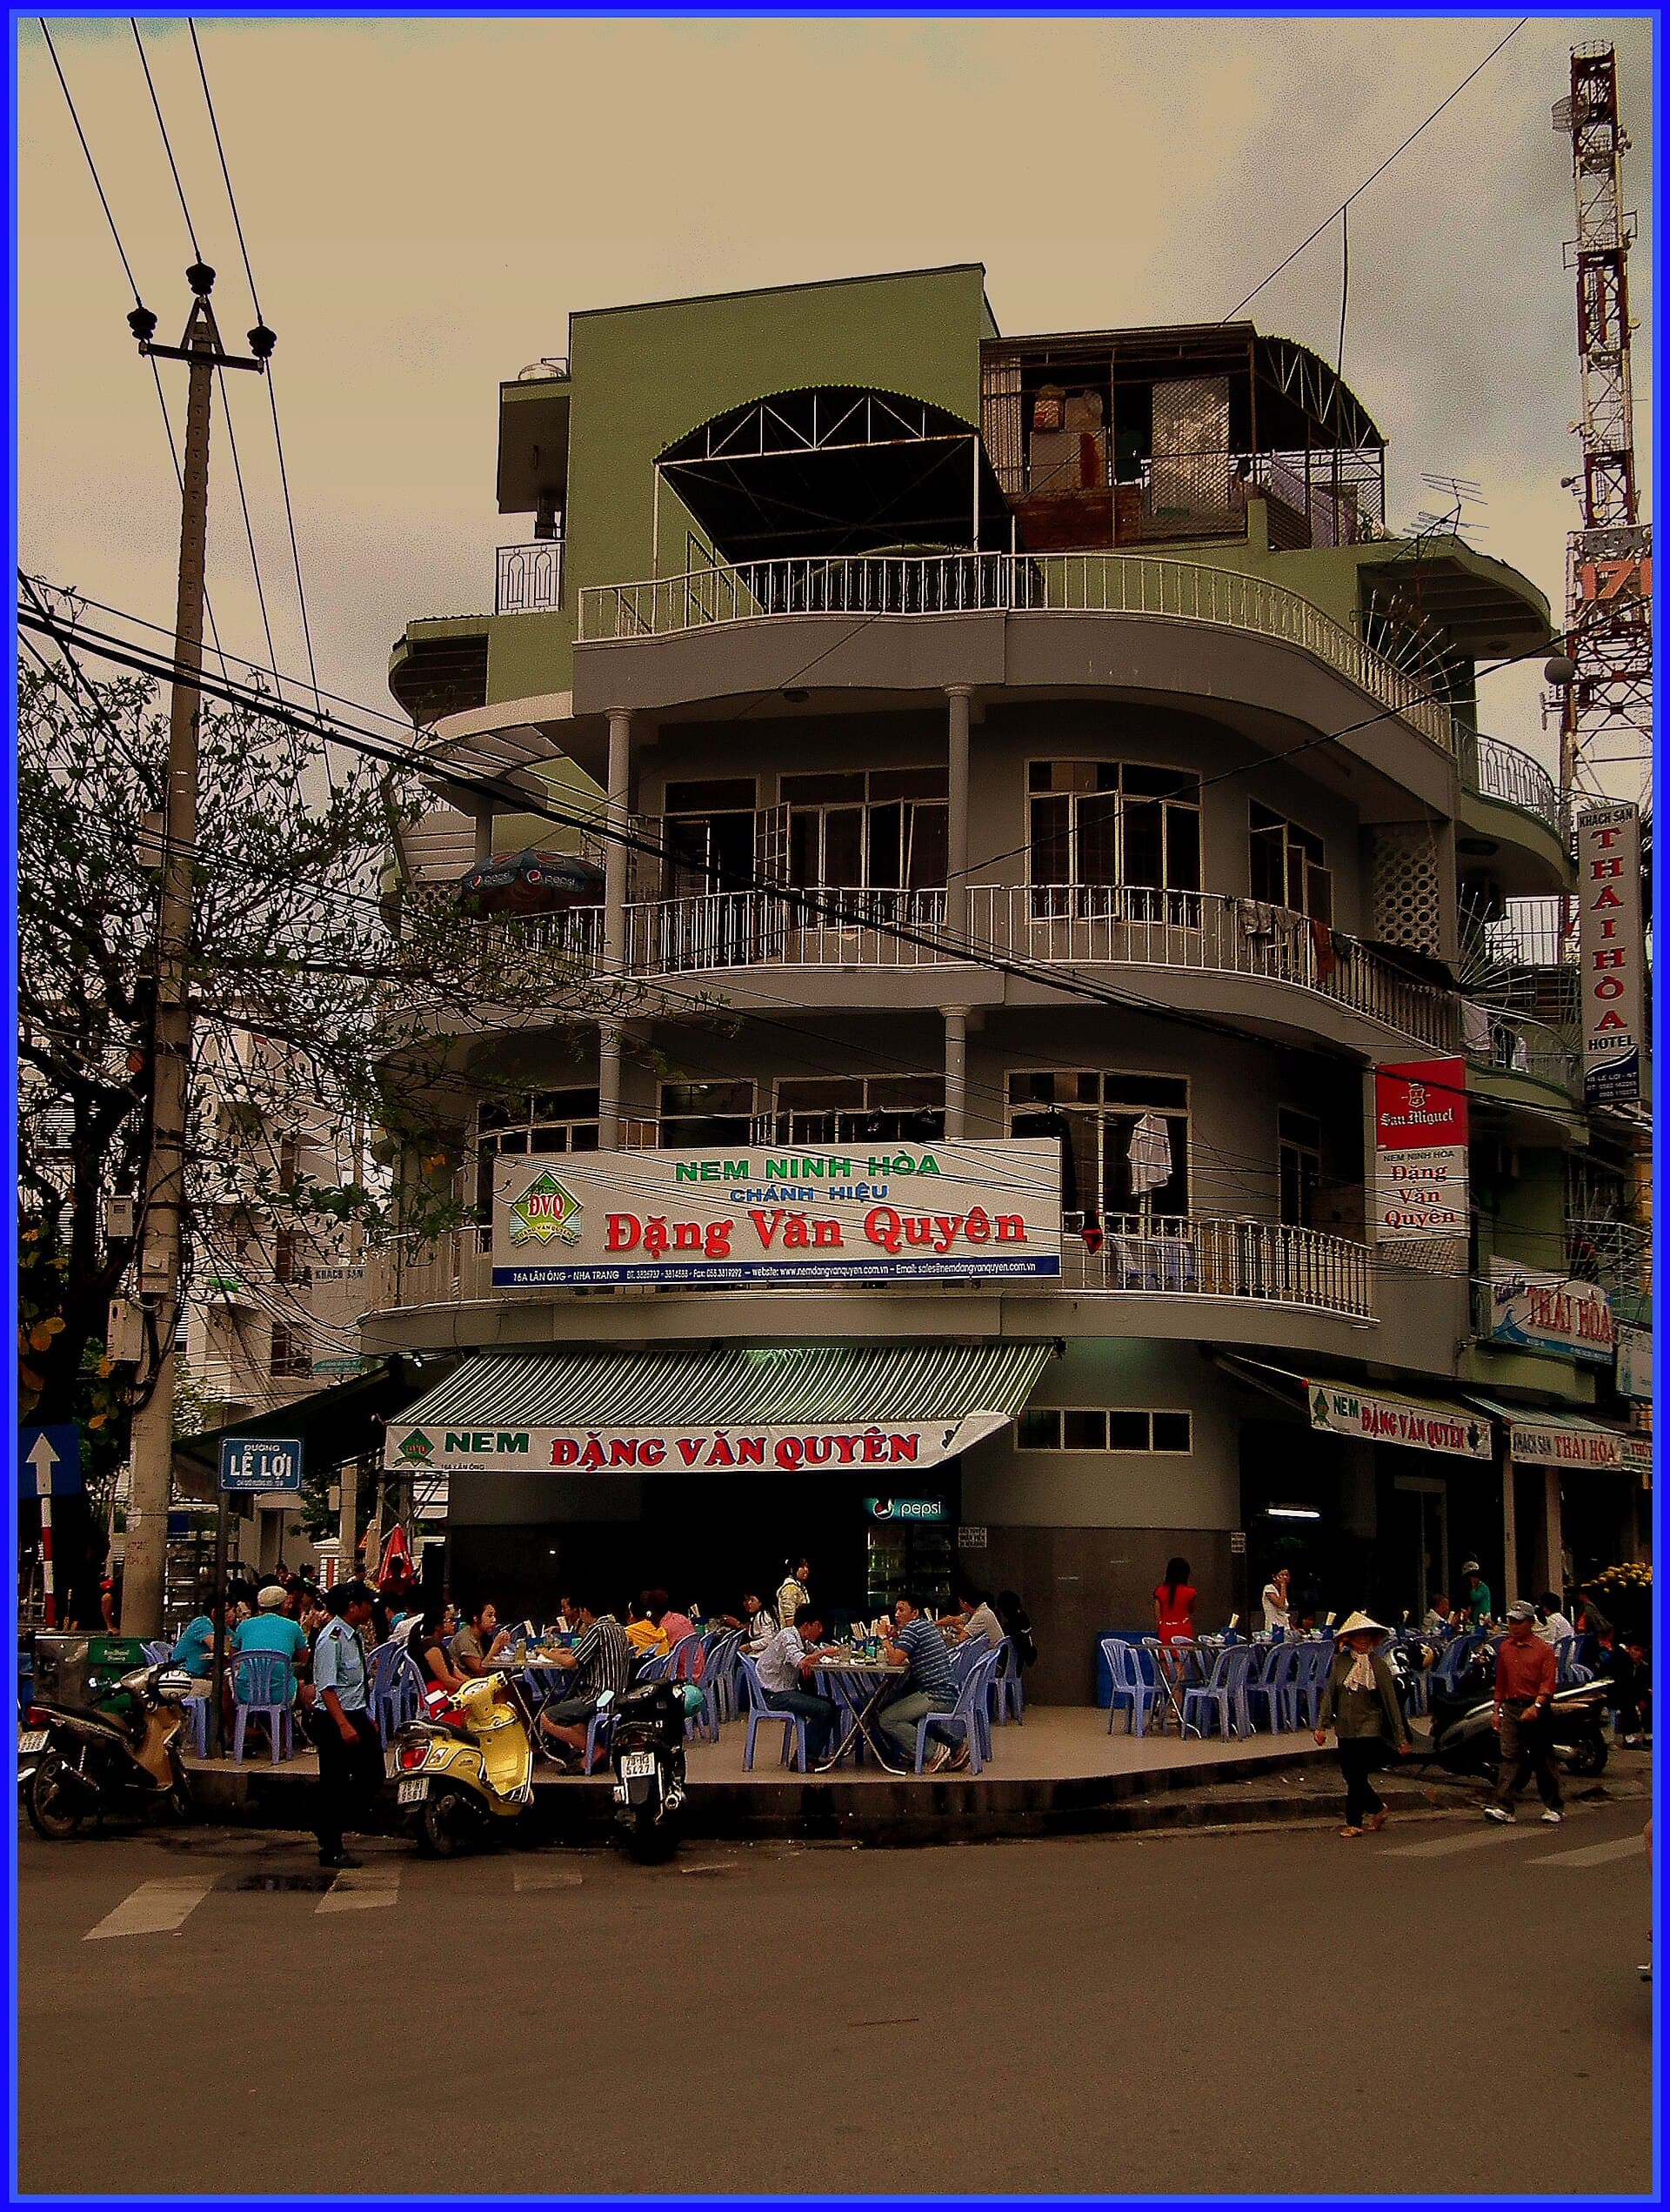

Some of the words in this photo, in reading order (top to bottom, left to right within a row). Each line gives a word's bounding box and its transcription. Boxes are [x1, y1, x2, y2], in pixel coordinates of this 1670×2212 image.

[1593, 946, 1627, 1032] HÒA
[1588, 1035, 1634, 1051] HOTEL
[1379, 1112, 1406, 1127] San
[1407, 1108, 1455, 1126] Miguel
[675, 1159, 749, 1181] NEM
[765, 1157, 852, 1179] NINH
[868, 1150, 941, 1177] HÒA
[1383, 1153, 1405, 1162] NEM
[1391, 1164, 1448, 1184] Đặng
[730, 1185, 815, 1203] CHÁNH
[829, 1181, 889, 1203] HIỆU
[1399, 1188, 1442, 1205] Văn
[1385, 1208, 1456, 1229] Quyên
[604, 1213, 734, 1260] Đặng
[748, 1208, 845, 1249] Văn
[863, 1206, 1028, 1254] Quyên
[513, 1273, 528, 1282] 16A
[573, 1271, 591, 1280] NHA
[592, 1270, 620, 1280] TRANG
[752, 1266, 779, 1277] website:
[896, 1264, 918, 1273] Email:
[1333, 1395, 1359, 1419] NEM
[1361, 1402, 1397, 1439] ĐẶNG
[1399, 1409, 1426, 1442] VĂN
[444, 1431, 530, 1454] NEM
[549, 1430, 668, 1472] ĐẶNG
[674, 1429, 768, 1467] VĂN
[773, 1426, 920, 1471] QUYÊN
[1590, 1434, 1617, 1463] HÒA
[230, 1452, 254, 1477] LÊ
[261, 1453, 293, 1480] LỢI
[900, 1500, 943, 1517] pepsi
